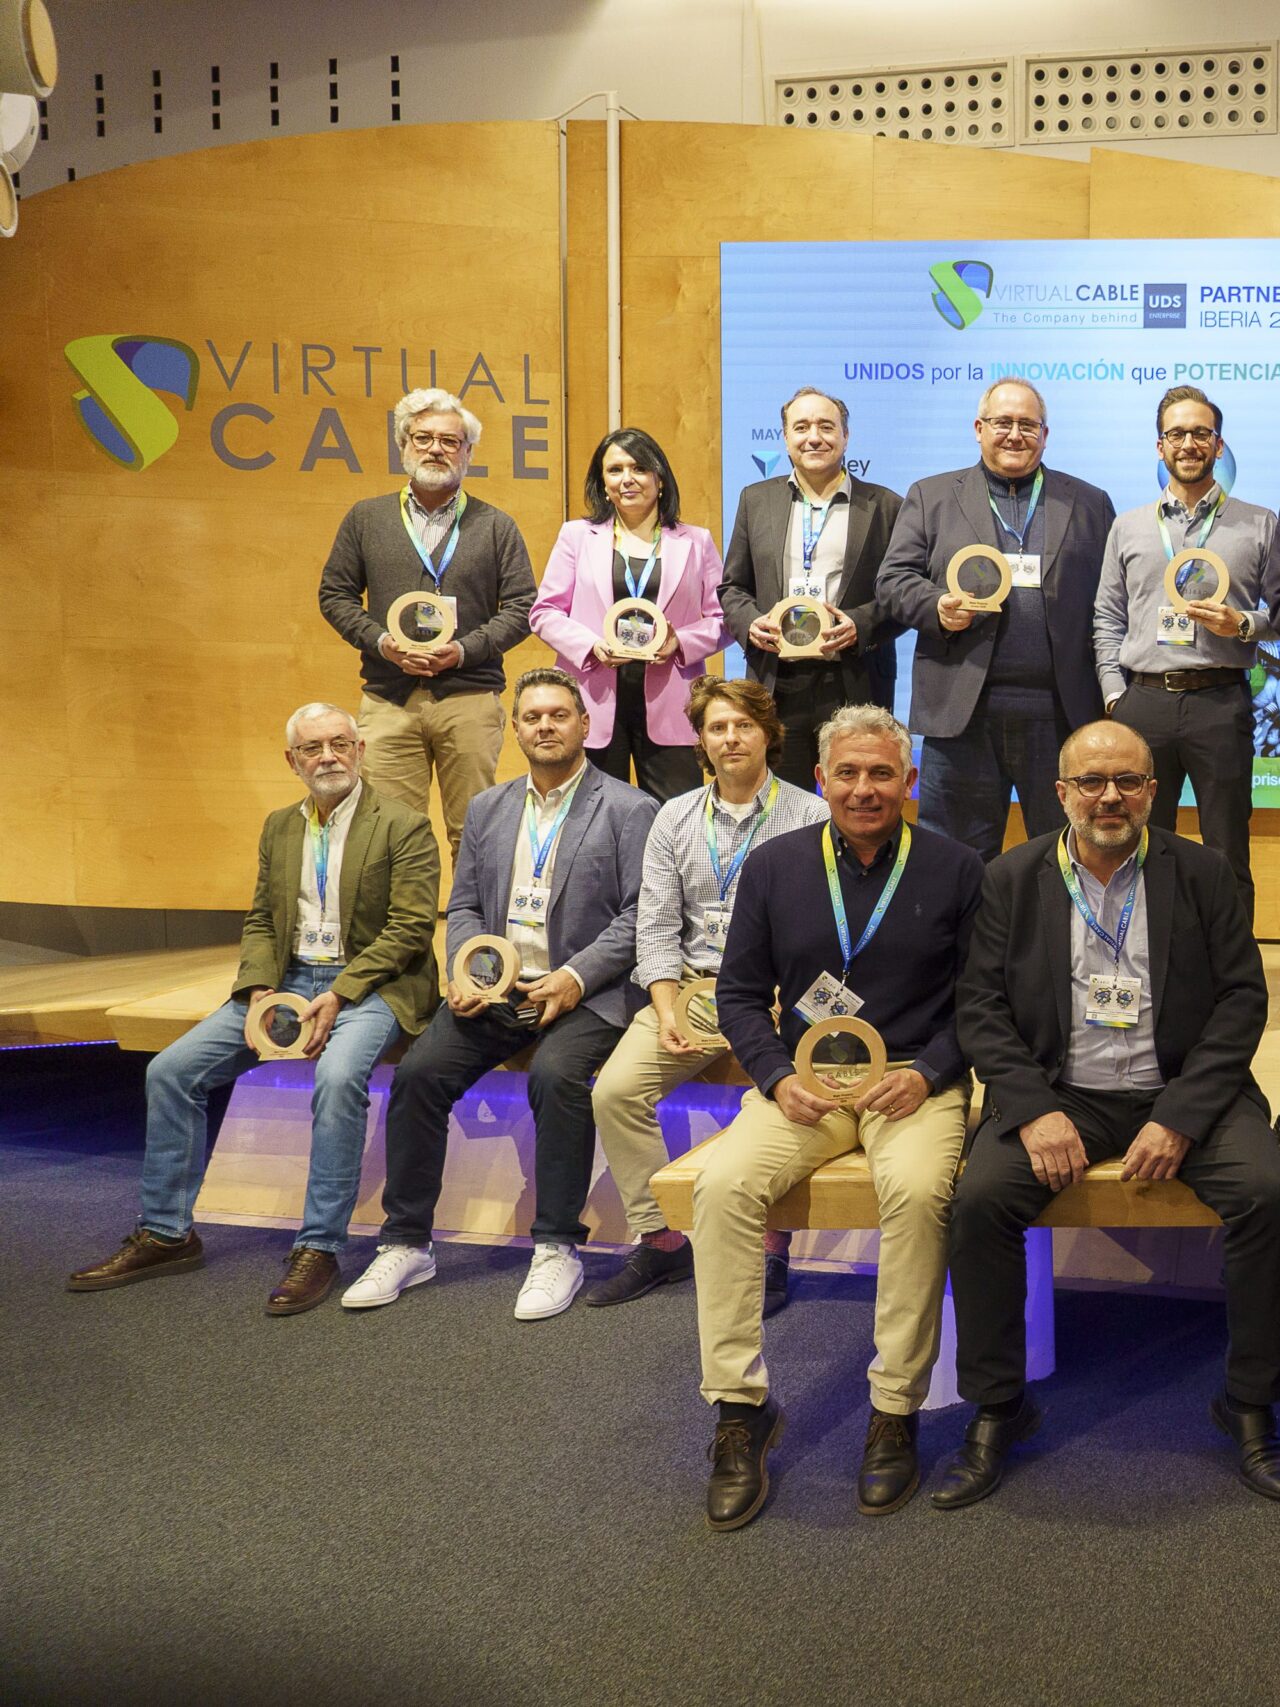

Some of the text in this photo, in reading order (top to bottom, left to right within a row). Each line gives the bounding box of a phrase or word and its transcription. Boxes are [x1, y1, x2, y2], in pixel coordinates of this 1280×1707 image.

[1149, 293, 1181, 309] UDS
[993, 311, 1138, 327] The Company behind
[1200, 311, 1262, 329] IBERIA
[206, 338, 550, 405] VIRTUAL
[843, 361, 925, 383] UNIDOS
[931, 365, 962, 386] por
[967, 362, 984, 382] la
[990, 357, 1125, 383] INNOVACIÓN
[1131, 366, 1167, 387] que
[210, 402, 549, 481] CAE
